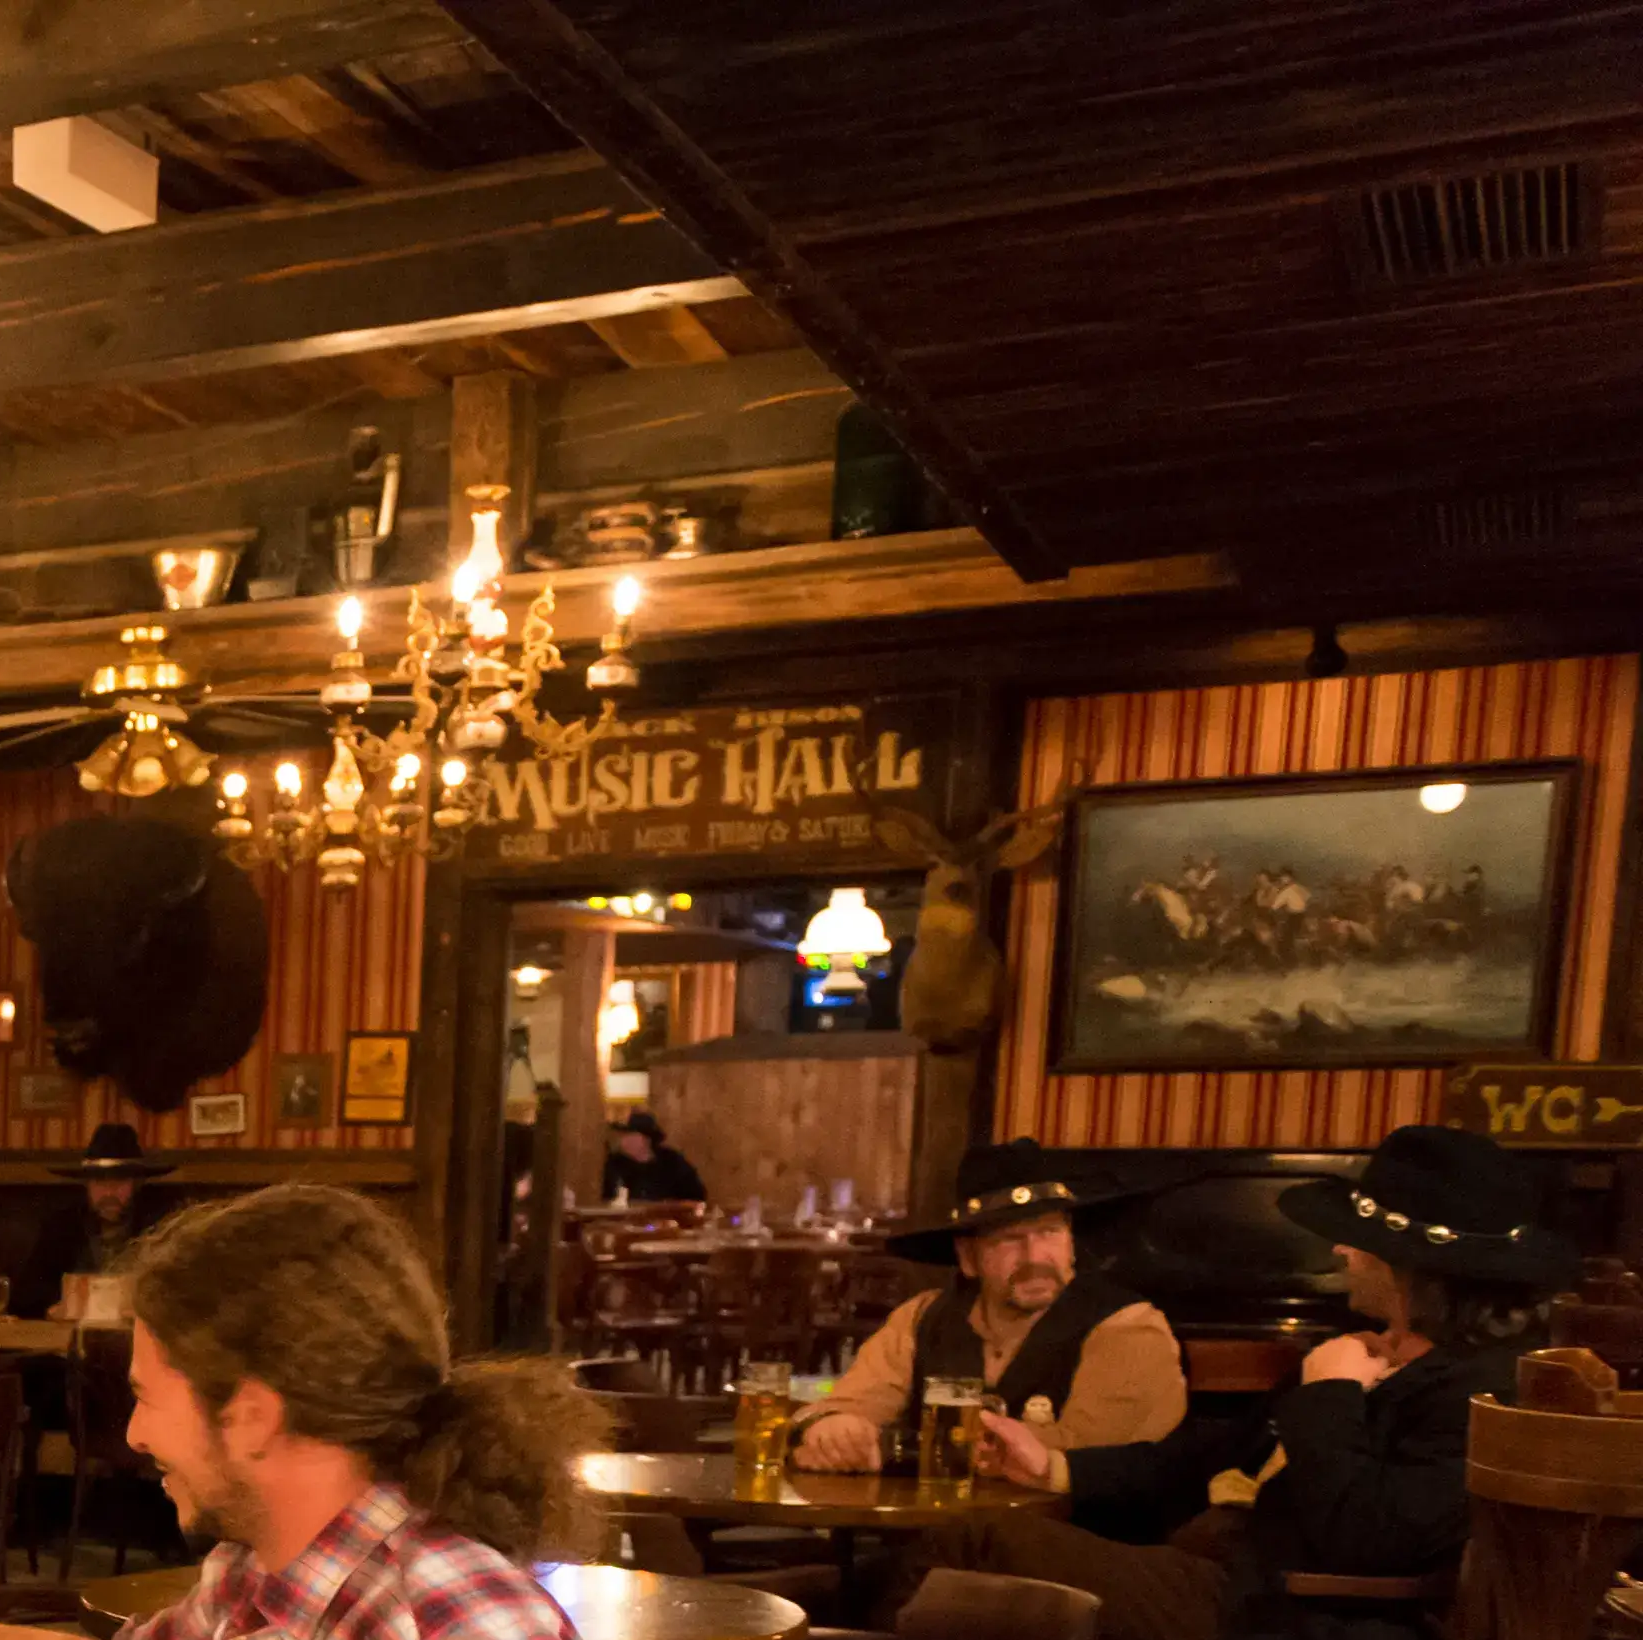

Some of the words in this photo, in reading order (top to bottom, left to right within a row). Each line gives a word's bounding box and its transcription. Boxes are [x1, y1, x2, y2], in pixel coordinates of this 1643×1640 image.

[481, 747, 701, 830] MUSIC
[708, 726, 922, 814] HALL
[1480, 1085, 1583, 1134] WC
